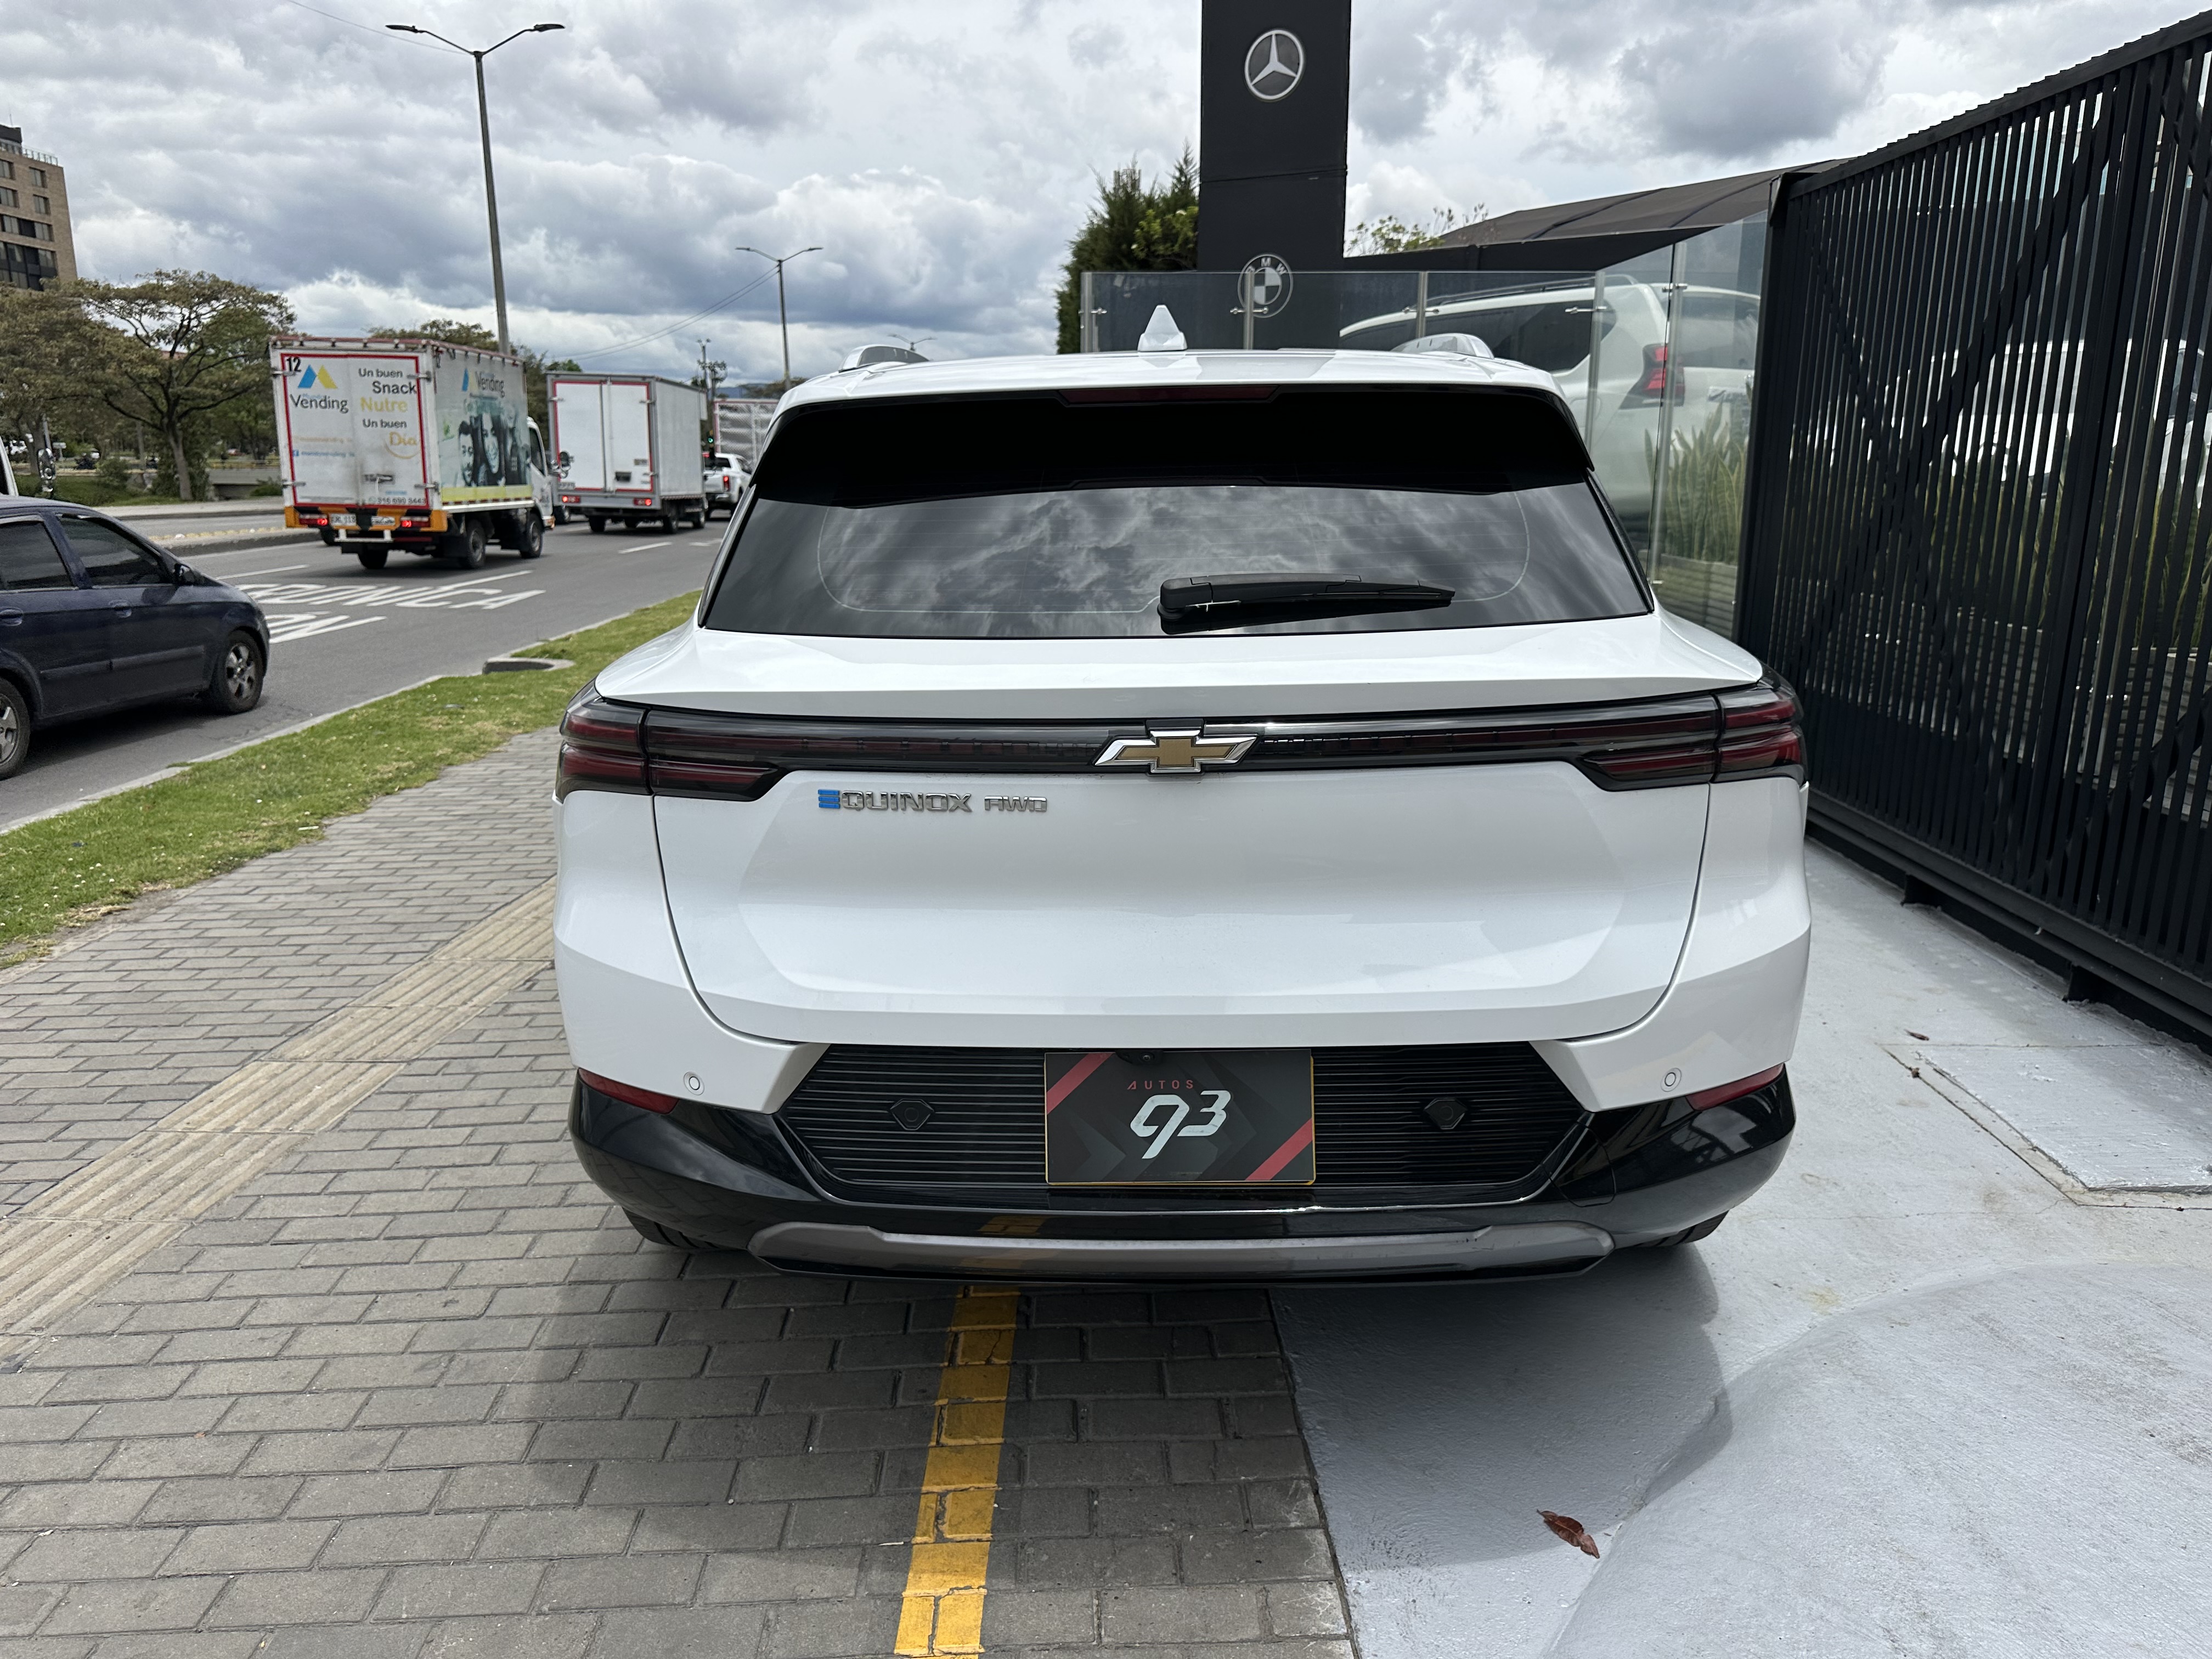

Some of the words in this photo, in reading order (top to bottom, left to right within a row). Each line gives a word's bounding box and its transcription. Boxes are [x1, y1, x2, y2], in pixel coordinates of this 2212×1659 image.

[286, 357, 302, 372] 12
[358, 368, 374, 378] Un
[376, 368, 403, 379] buen
[372, 380, 417, 395] Snack
[475, 371, 505, 398] Vending
[290, 394, 349, 414] Vending
[360, 396, 408, 412] Nutre
[363, 417, 378, 428] Un
[380, 419, 407, 428] buen
[817, 789, 973, 812] EQUINOX
[984, 795, 1047, 812] AWD
[1127, 1079, 1194, 1090] AUTOS
[1130, 1090, 1232, 1159] 93
